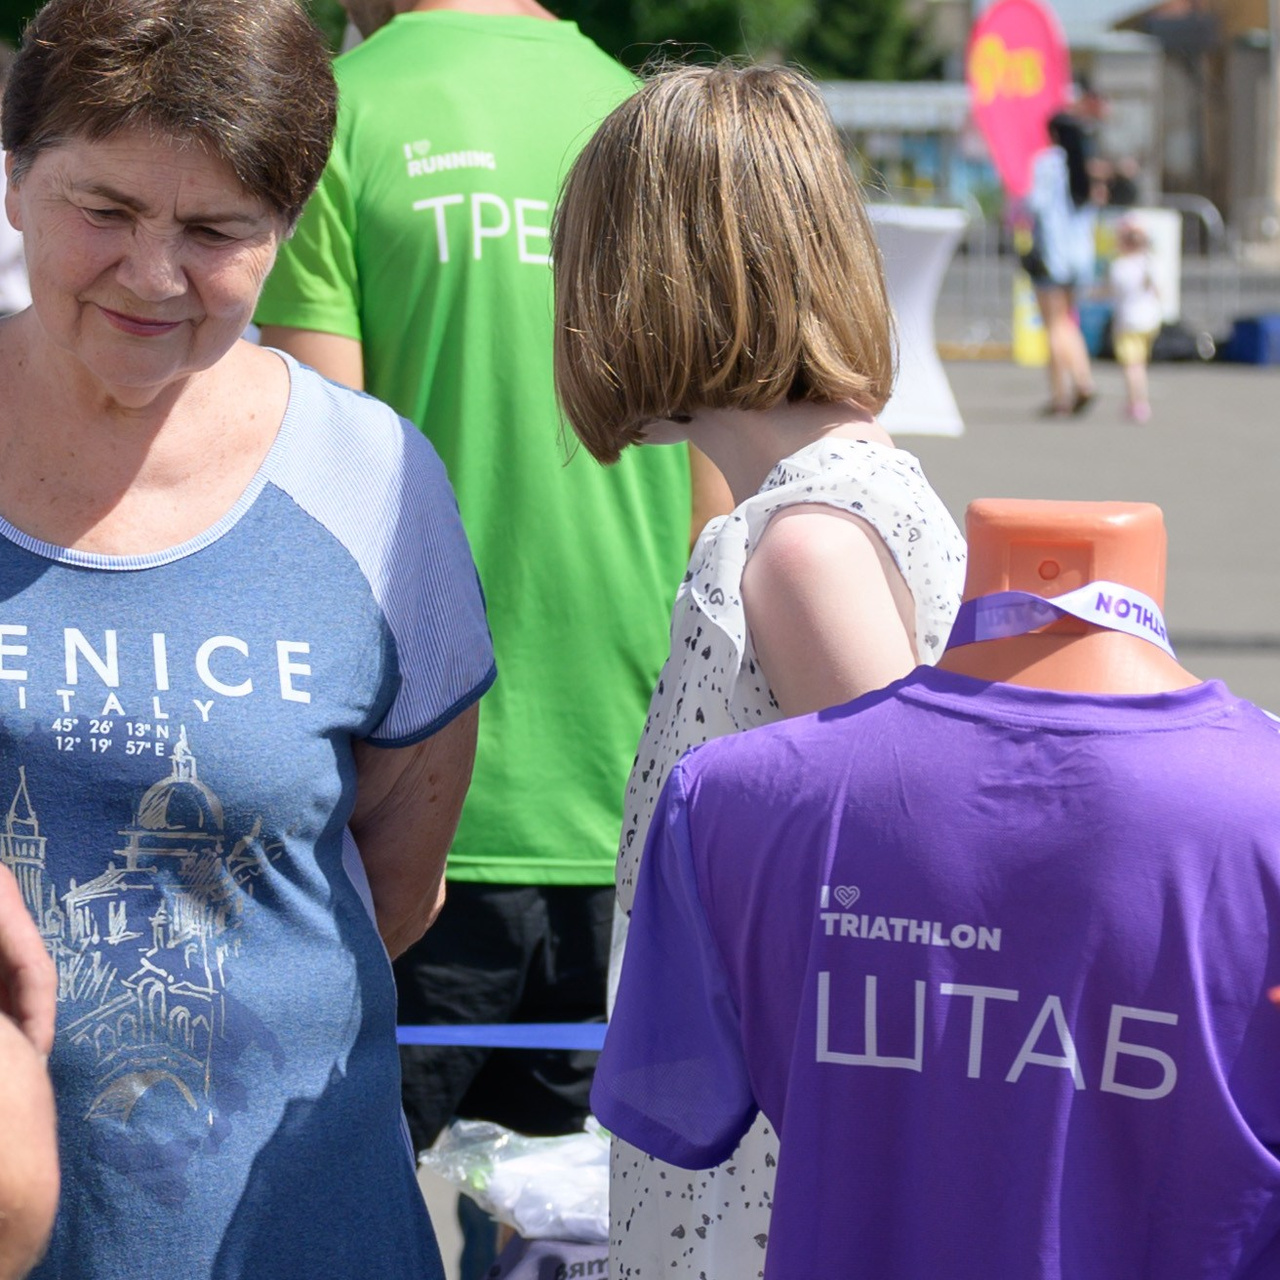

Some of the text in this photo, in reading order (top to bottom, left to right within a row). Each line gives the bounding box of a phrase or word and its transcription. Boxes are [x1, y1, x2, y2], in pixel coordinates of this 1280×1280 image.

[403, 142, 413, 160] I
[412, 192, 554, 265] ТРЕ
[18, 685, 214, 722] ITALY
[52, 718, 79, 732] 45°
[156, 724, 170, 739] N
[56, 736, 81, 751] 12°
[155, 742, 165, 756] E
[820, 885, 830, 909] I
[820, 913, 1002, 952] TRIATHLON
[816, 971, 1179, 1101] ШТАБ
